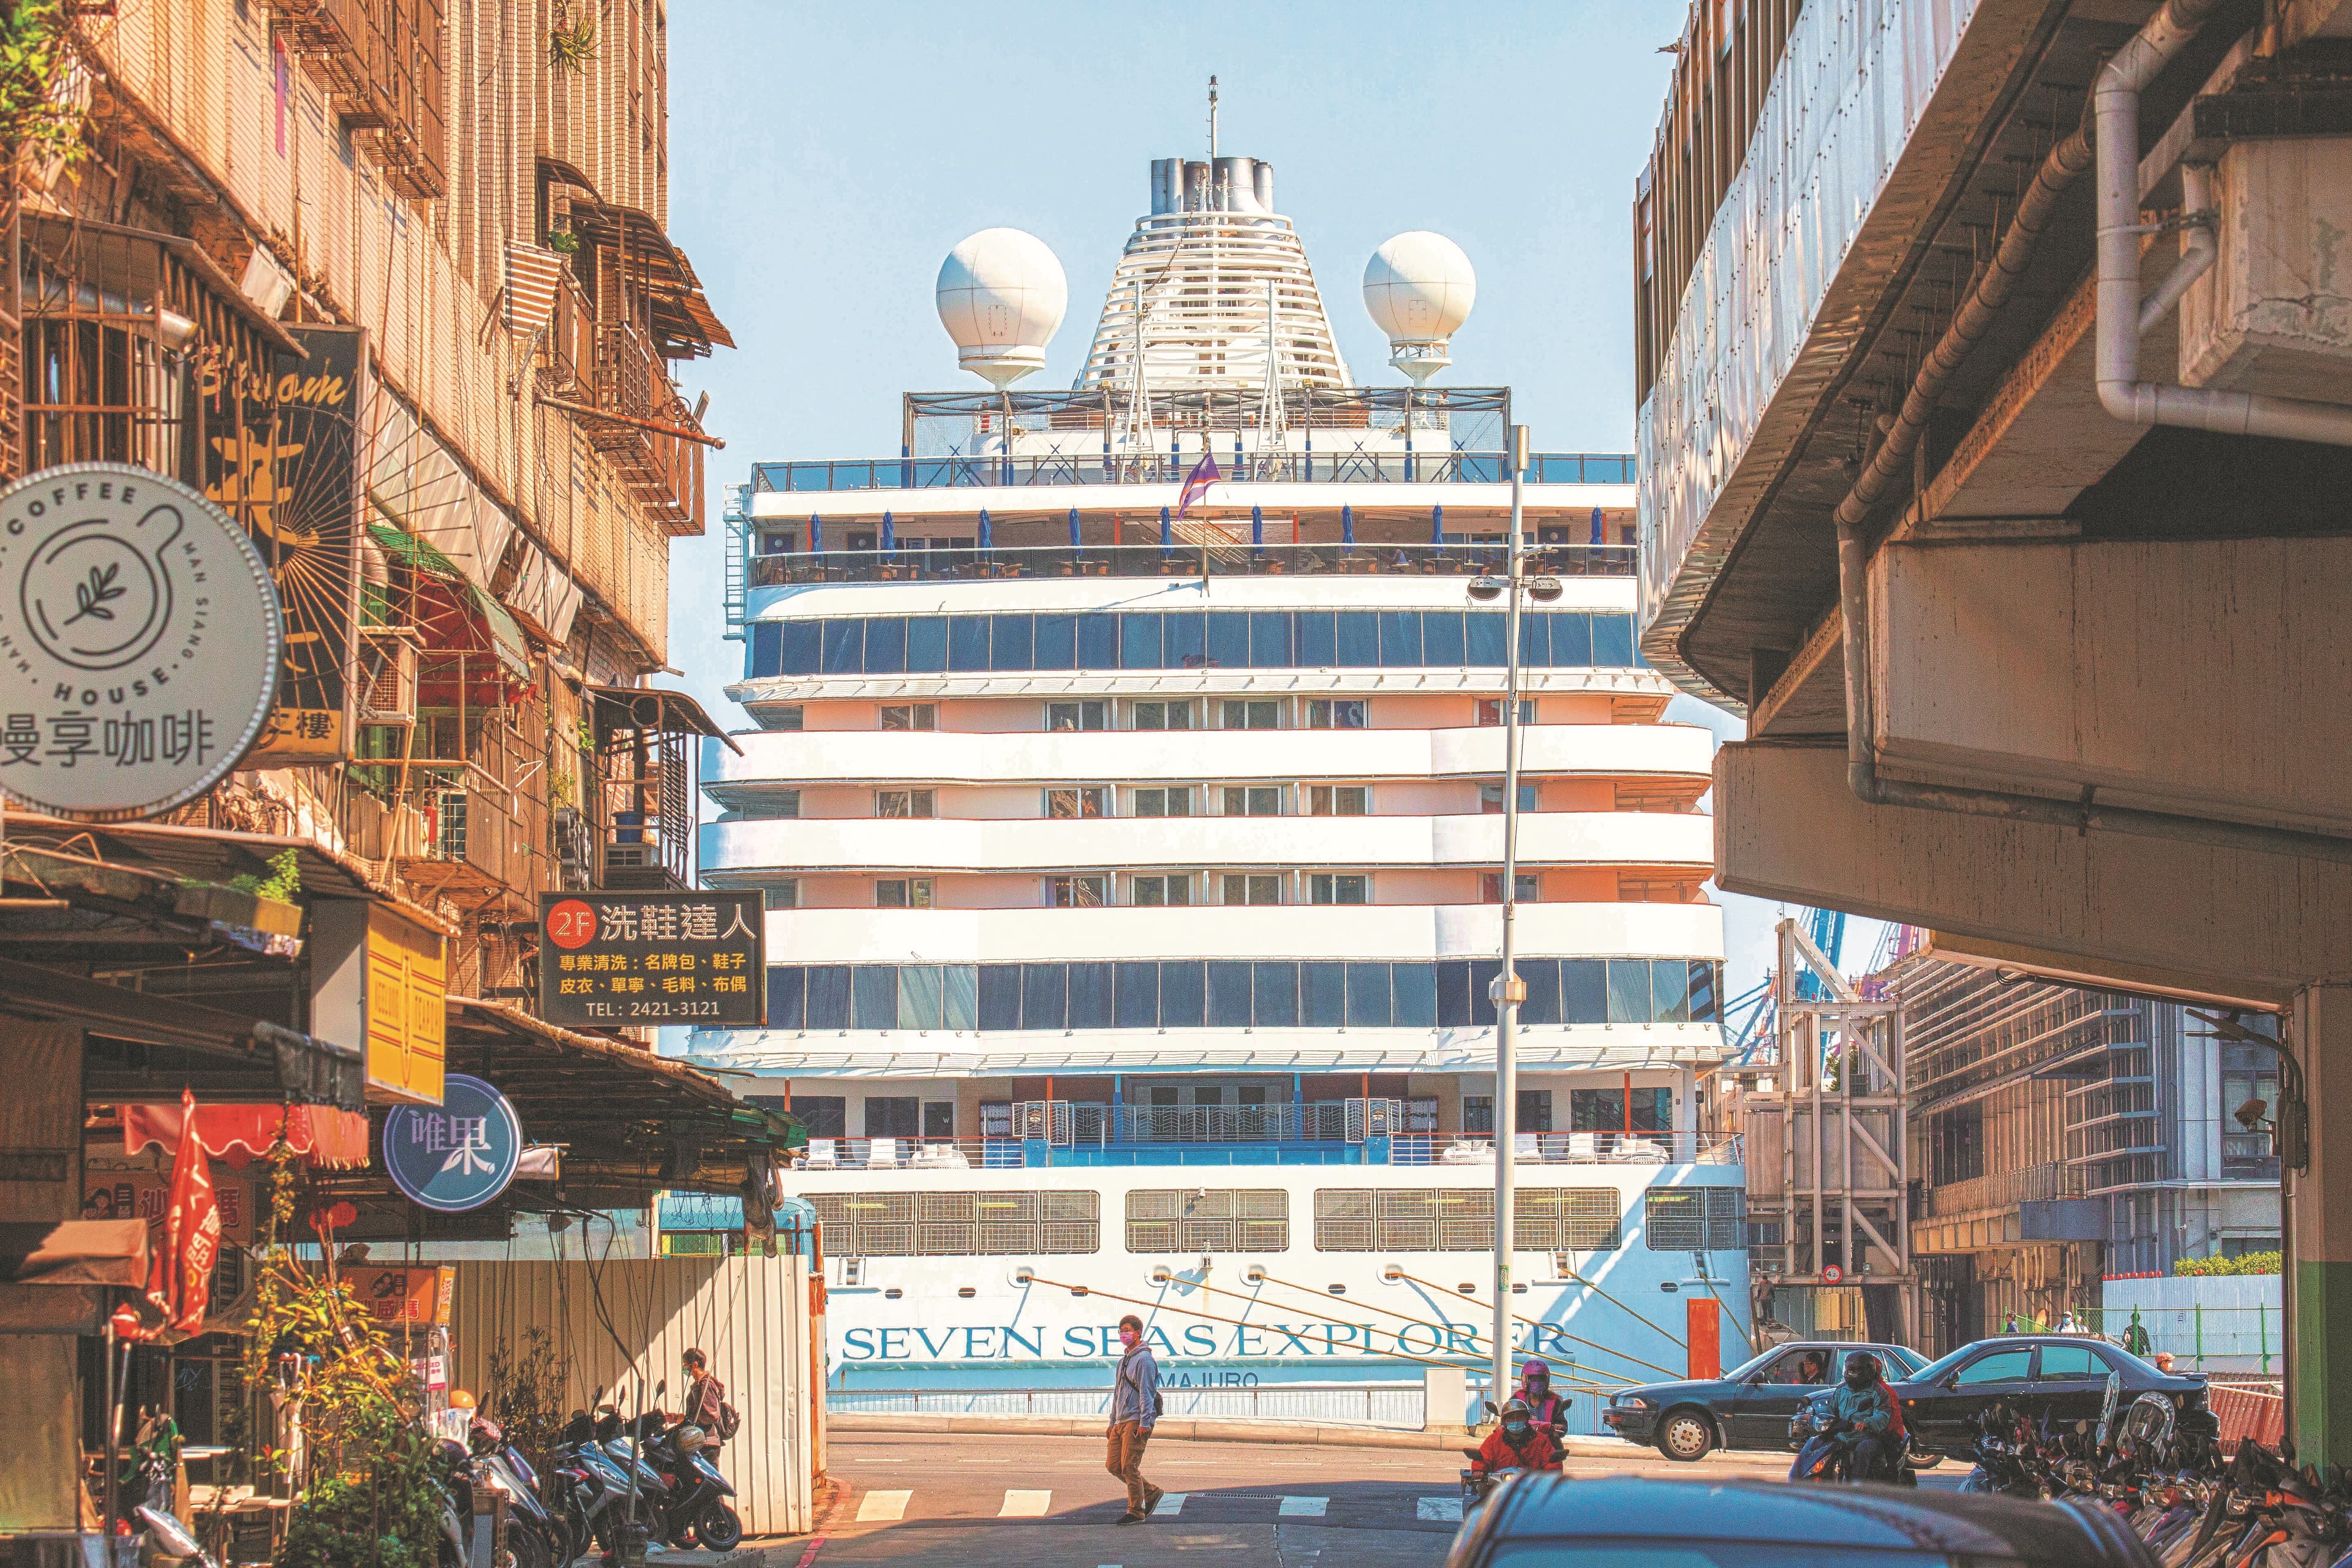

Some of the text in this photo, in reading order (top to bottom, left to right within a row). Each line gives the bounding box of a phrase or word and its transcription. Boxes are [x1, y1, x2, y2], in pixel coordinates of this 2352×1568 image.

[7, 483, 137, 535] COFFEE
[181, 541, 209, 659] MAN SIANG
[53, 666, 169, 706] HOUSE
[555, 912, 590, 936] 2F
[600, 904, 756, 941] 洗鞋達人
[630, 1001, 720, 1017] 2421-3121
[409, 1110, 495, 1175] 唯果
[842, 1326, 1046, 1360] SEVEN
[1063, 1325, 1216, 1357] SEAS
